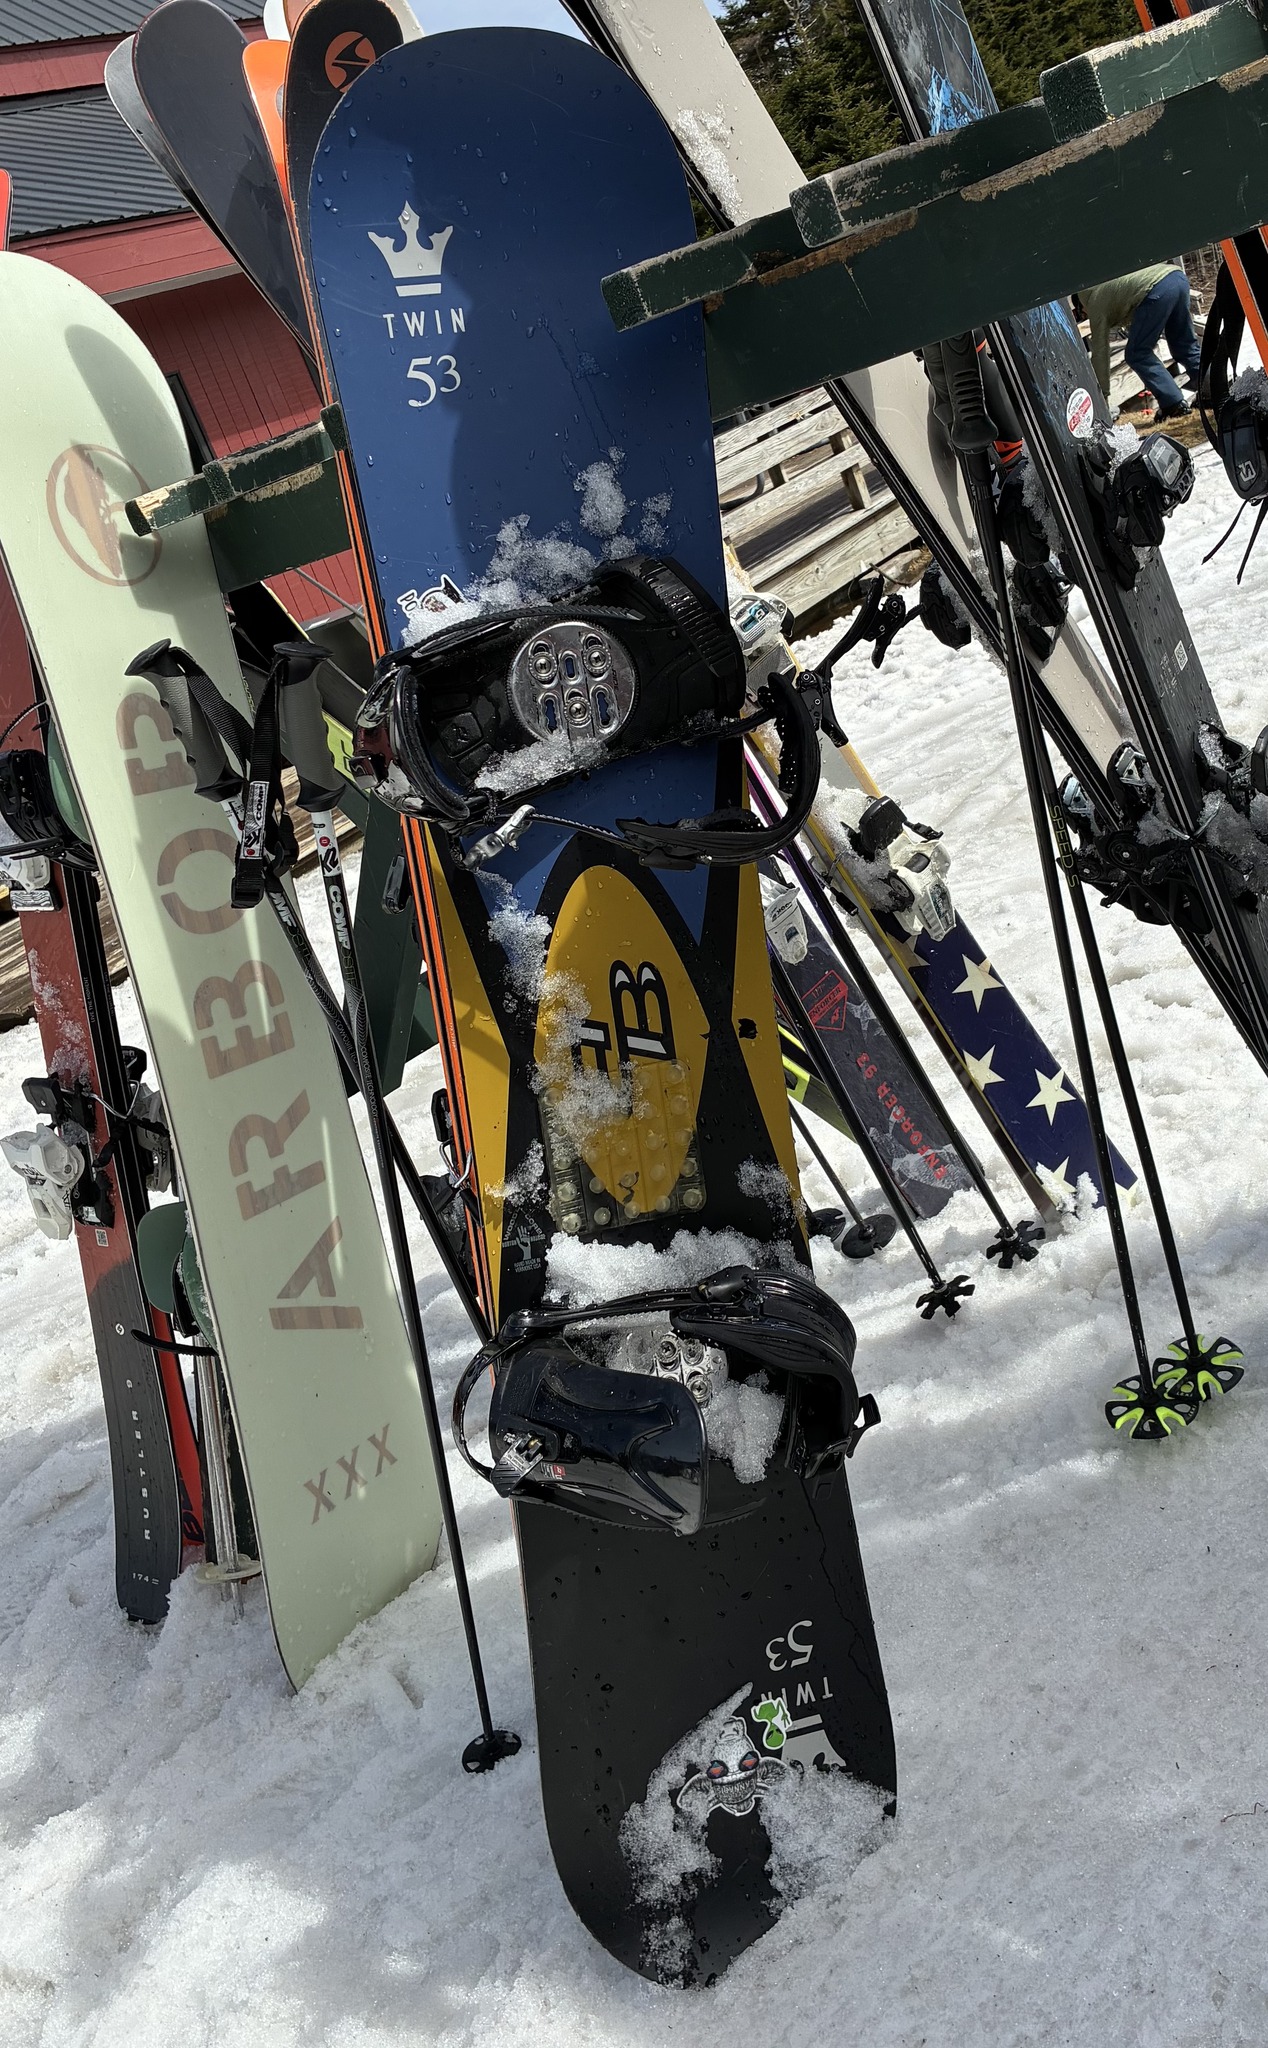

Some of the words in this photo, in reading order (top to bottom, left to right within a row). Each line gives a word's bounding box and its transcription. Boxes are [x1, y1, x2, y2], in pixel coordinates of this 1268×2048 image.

[383, 307, 466, 339] TWIN
[406, 354, 461, 408] 53
[1049, 805, 1075, 869] SPEED
[856, 1051, 878, 1079] 93
[876, 1081, 948, 1181] ENFORCER
[131, 1410, 151, 1540] RUSTLER
[303, 1423, 398, 1525] XXX
[765, 1619, 814, 1672] 53
